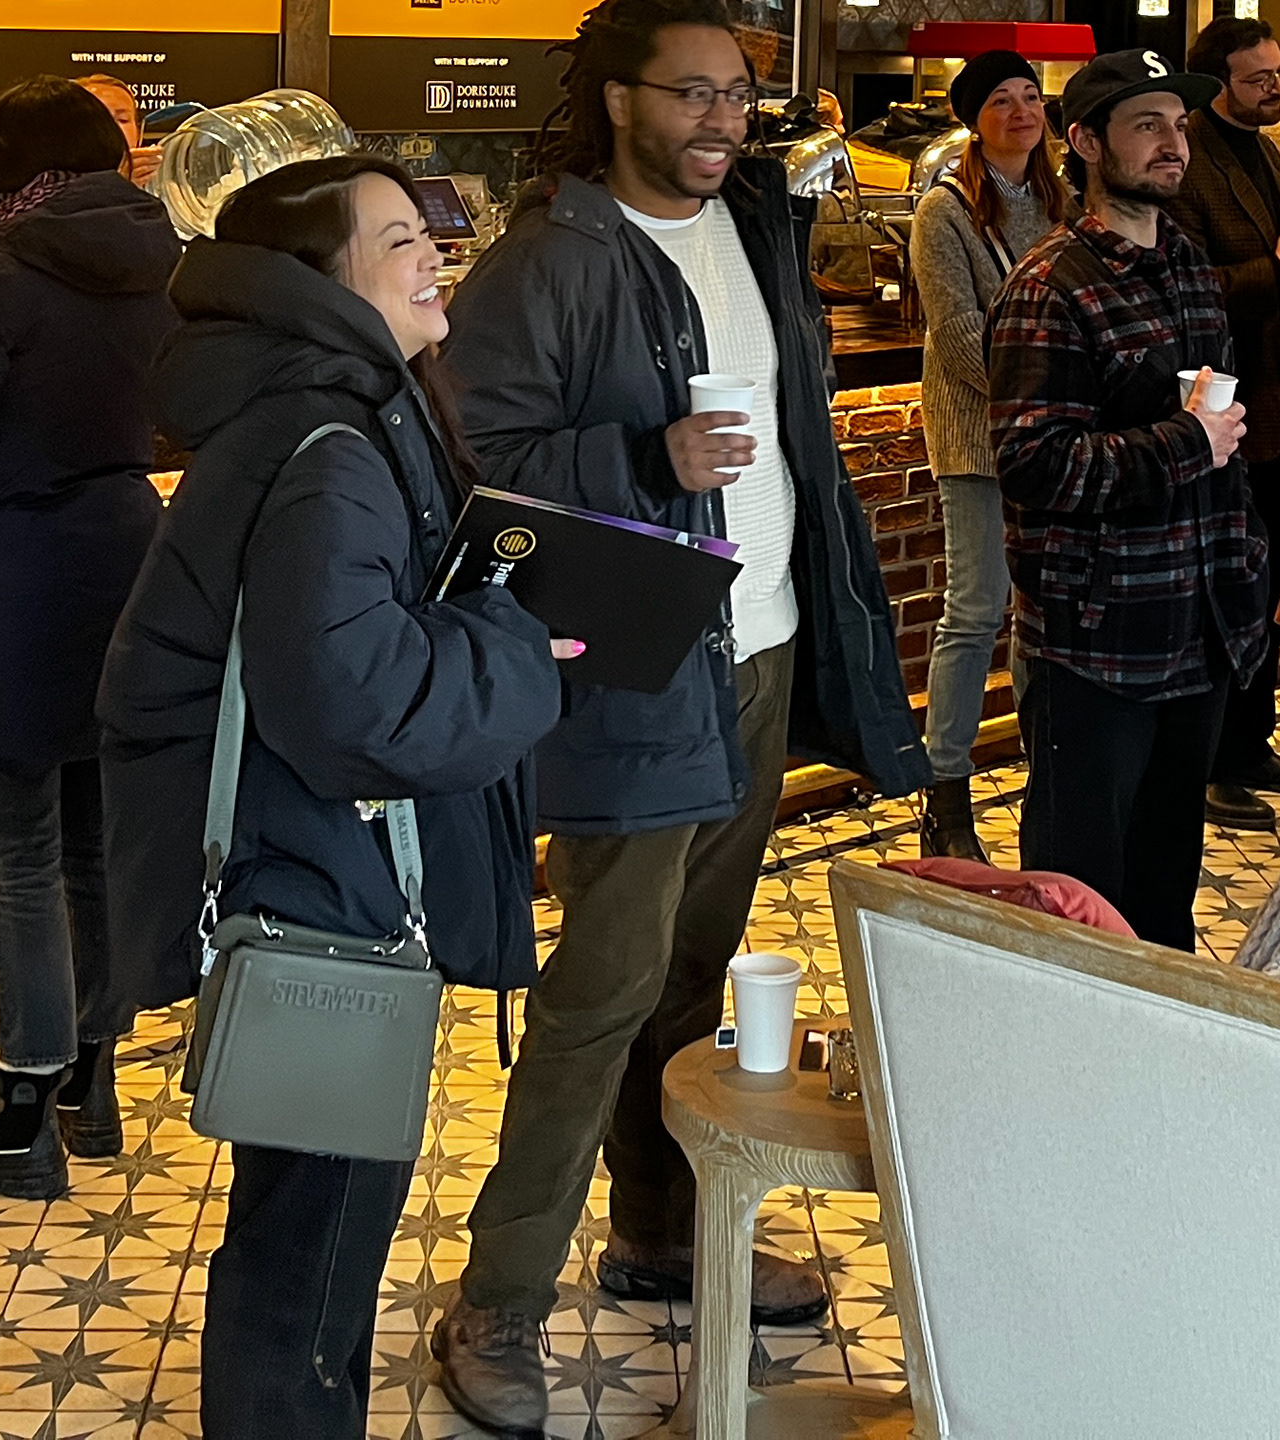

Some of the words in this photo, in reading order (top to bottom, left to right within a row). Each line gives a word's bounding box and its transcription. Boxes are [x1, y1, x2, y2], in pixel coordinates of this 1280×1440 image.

[71, 53, 94, 62] WITH
[96, 53, 112, 62] THE
[114, 53, 152, 62] SUPPORT
[154, 54, 166, 63] OF
[1142, 50, 1168, 78] S
[141, 83, 176, 97] DUKE
[457, 85, 487, 97] DORIS
[489, 85, 516, 97] DUKE
[456, 99, 517, 109] FOUNDATION
